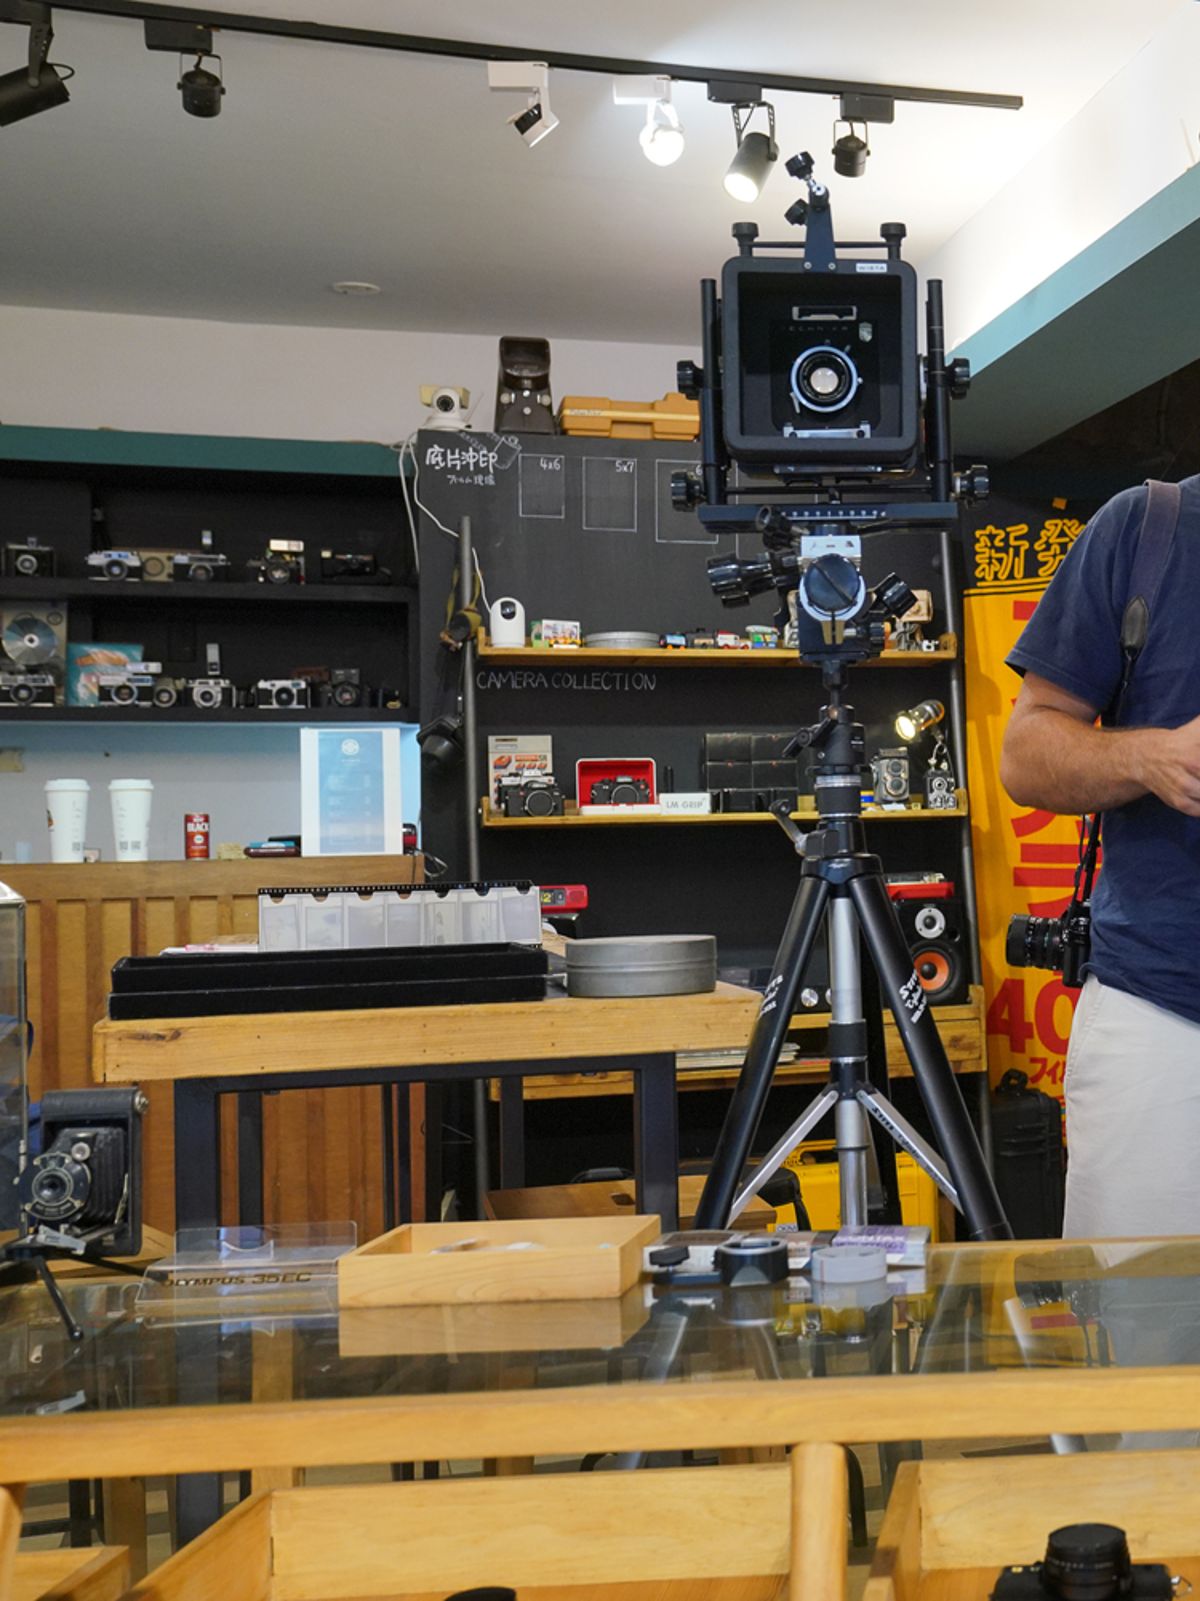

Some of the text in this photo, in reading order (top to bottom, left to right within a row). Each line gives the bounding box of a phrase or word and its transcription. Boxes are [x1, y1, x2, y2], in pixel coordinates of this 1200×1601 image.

[476, 671, 657, 690] CAMERA COLLECTION
[1028, 1056, 1067, 1085] フィ
[252, 1272, 312, 1284] 35EC
